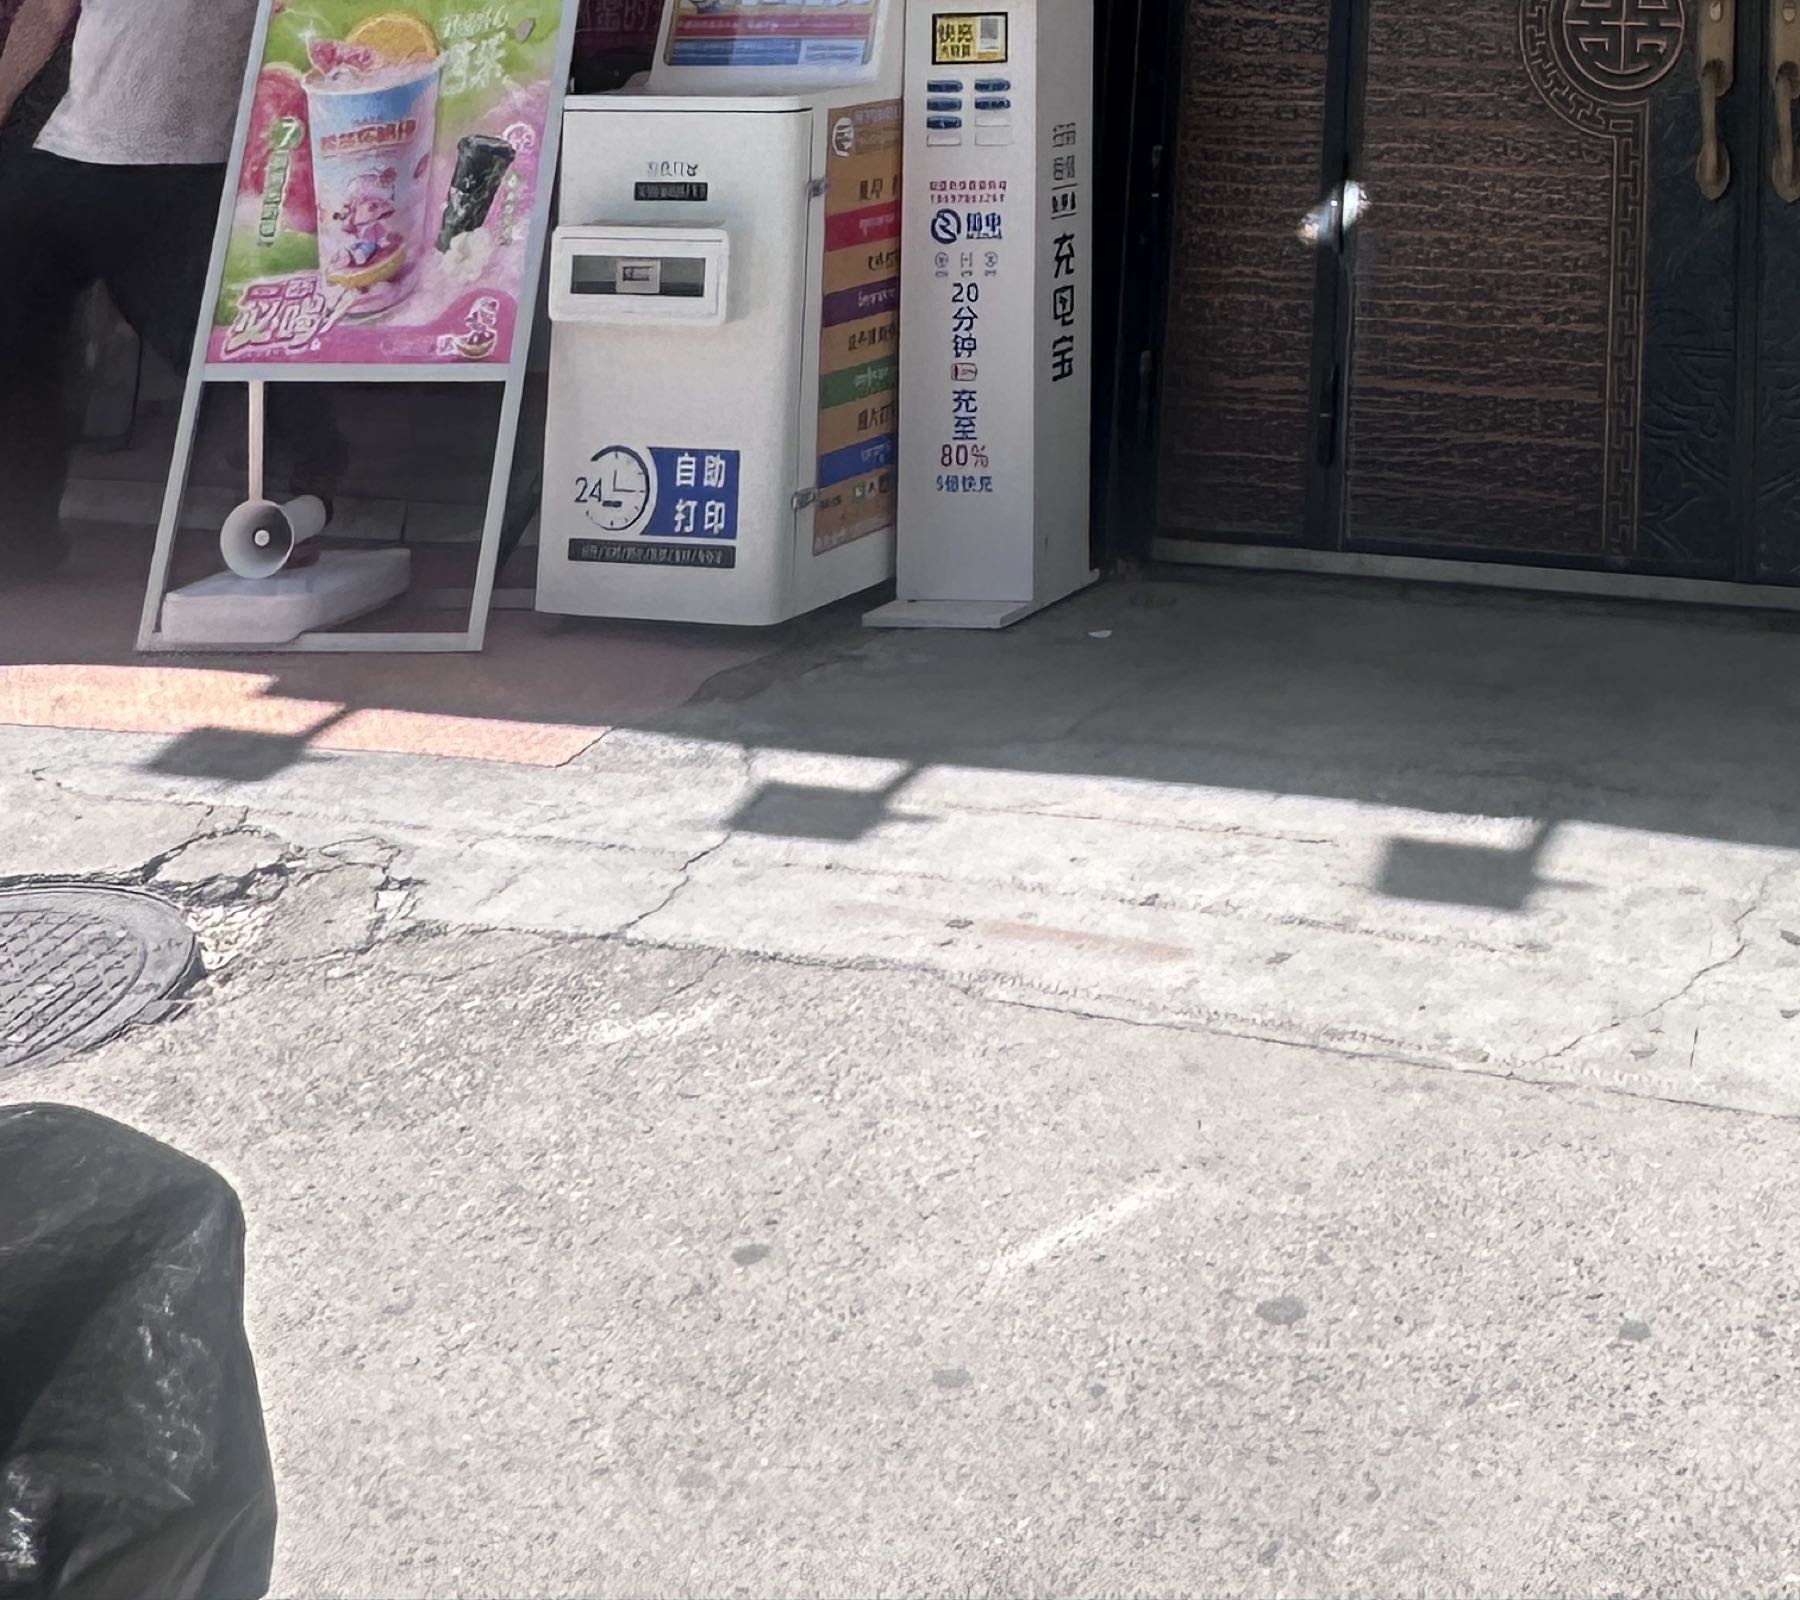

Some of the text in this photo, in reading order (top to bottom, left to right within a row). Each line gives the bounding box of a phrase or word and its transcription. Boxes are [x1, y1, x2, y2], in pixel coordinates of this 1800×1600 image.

[675, 452, 726, 489] 自助
[941, 443, 989, 469] 80%
[574, 476, 602, 504] 24
[673, 498, 726, 535] 打印
